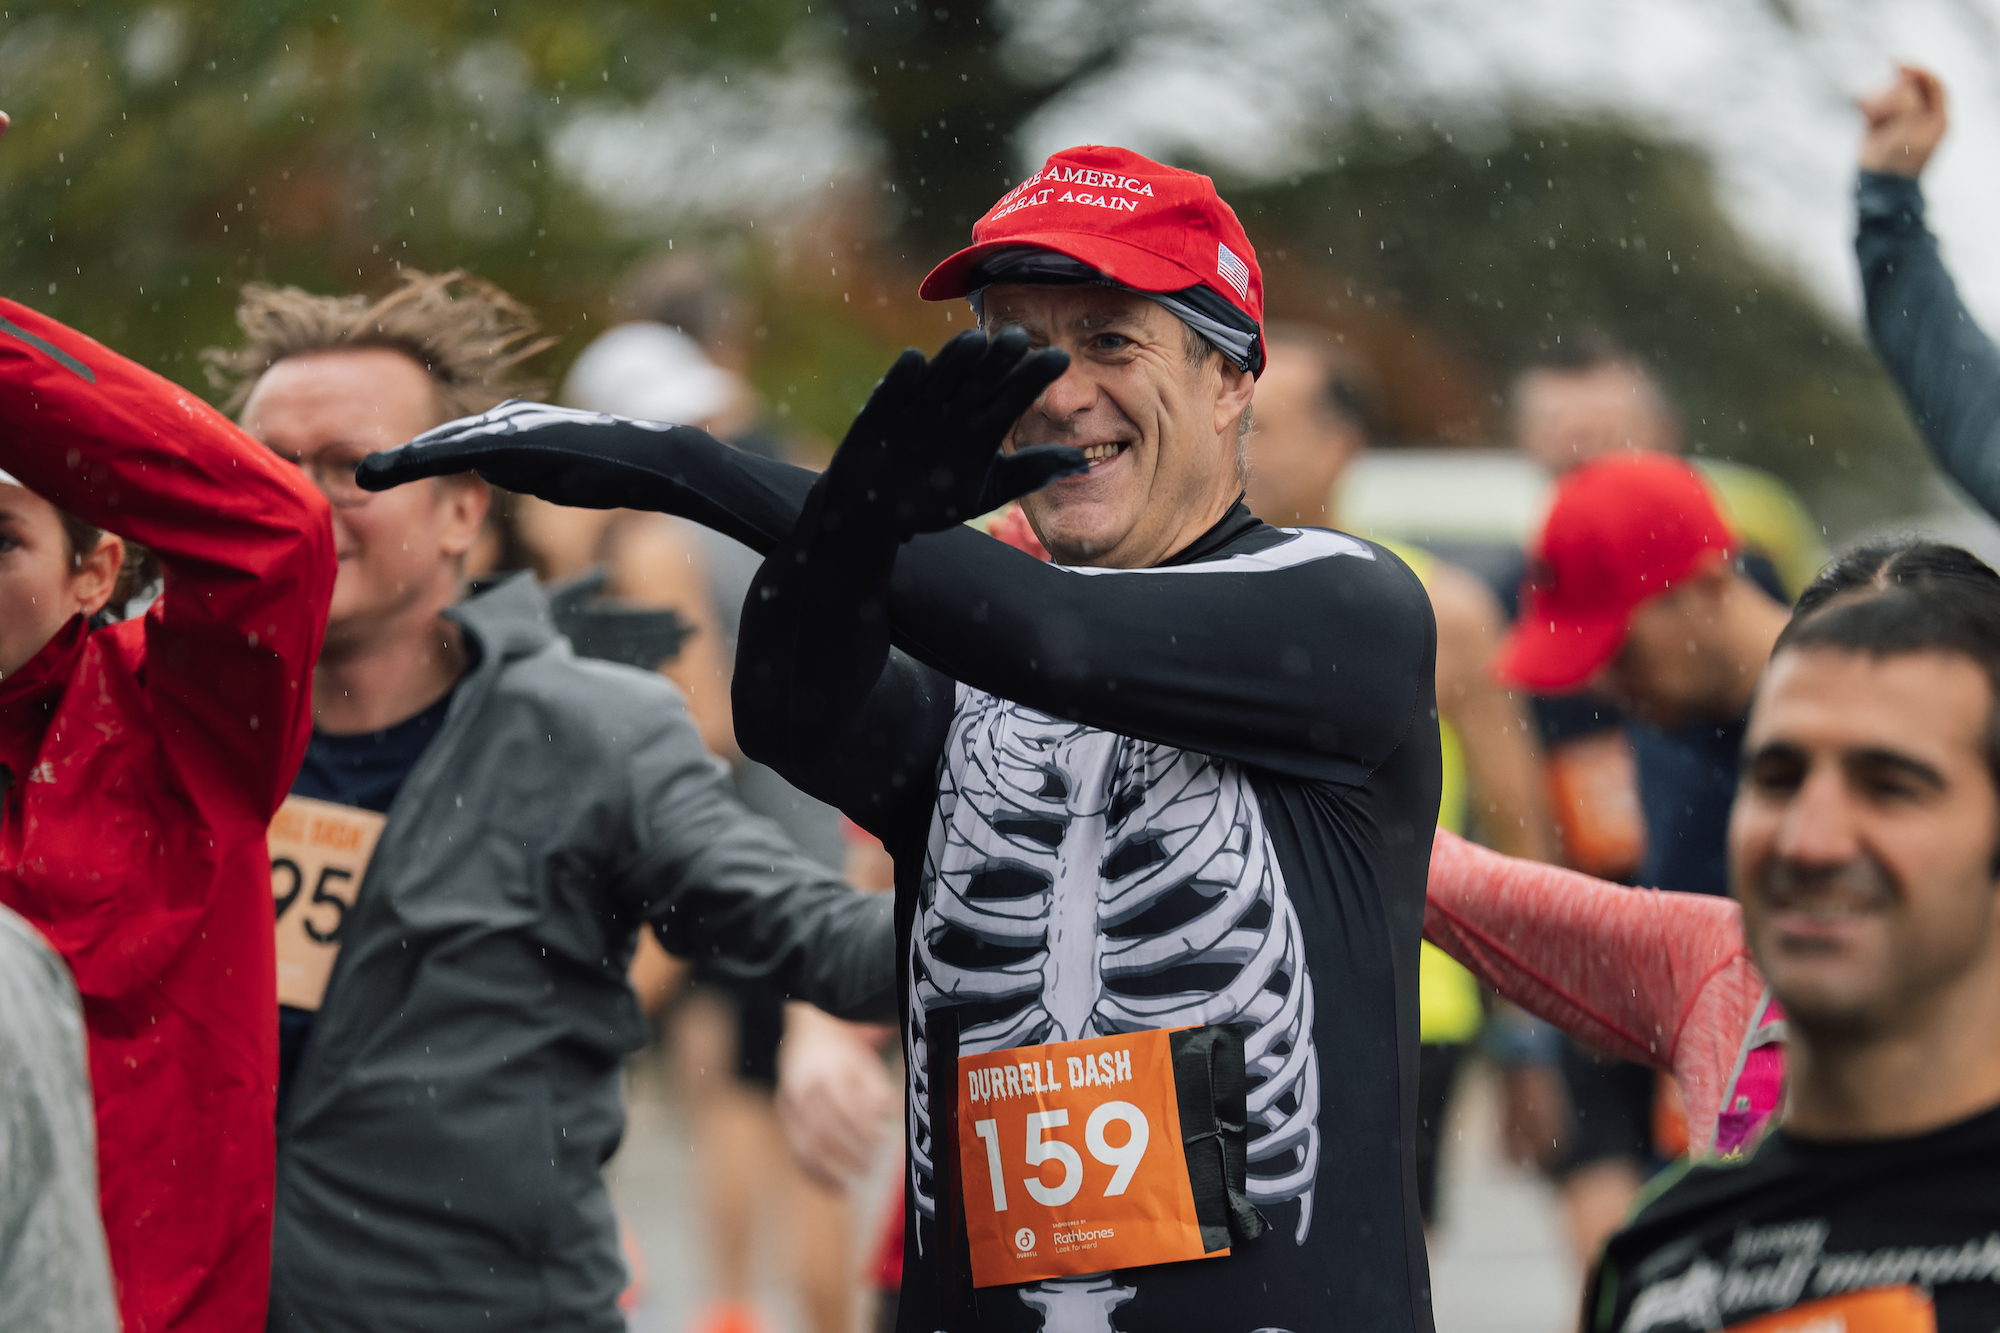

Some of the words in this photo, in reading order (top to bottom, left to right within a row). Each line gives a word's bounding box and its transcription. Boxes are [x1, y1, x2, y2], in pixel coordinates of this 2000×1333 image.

[1044, 165, 1155, 198] AMERICA
[991, 187, 1055, 222] GREAT
[1057, 190, 1139, 212] AGAIN
[968, 1059, 1062, 1105] DURRELL
[1066, 1049, 1133, 1089] DASH
[974, 1100, 1150, 1212] 159
[1053, 1228, 1115, 1245] Rathbones
[1055, 1246, 1070, 1254] Look
[1071, 1241, 1098, 1252] forward
[1016, 1251, 1038, 1259] DURRELL
